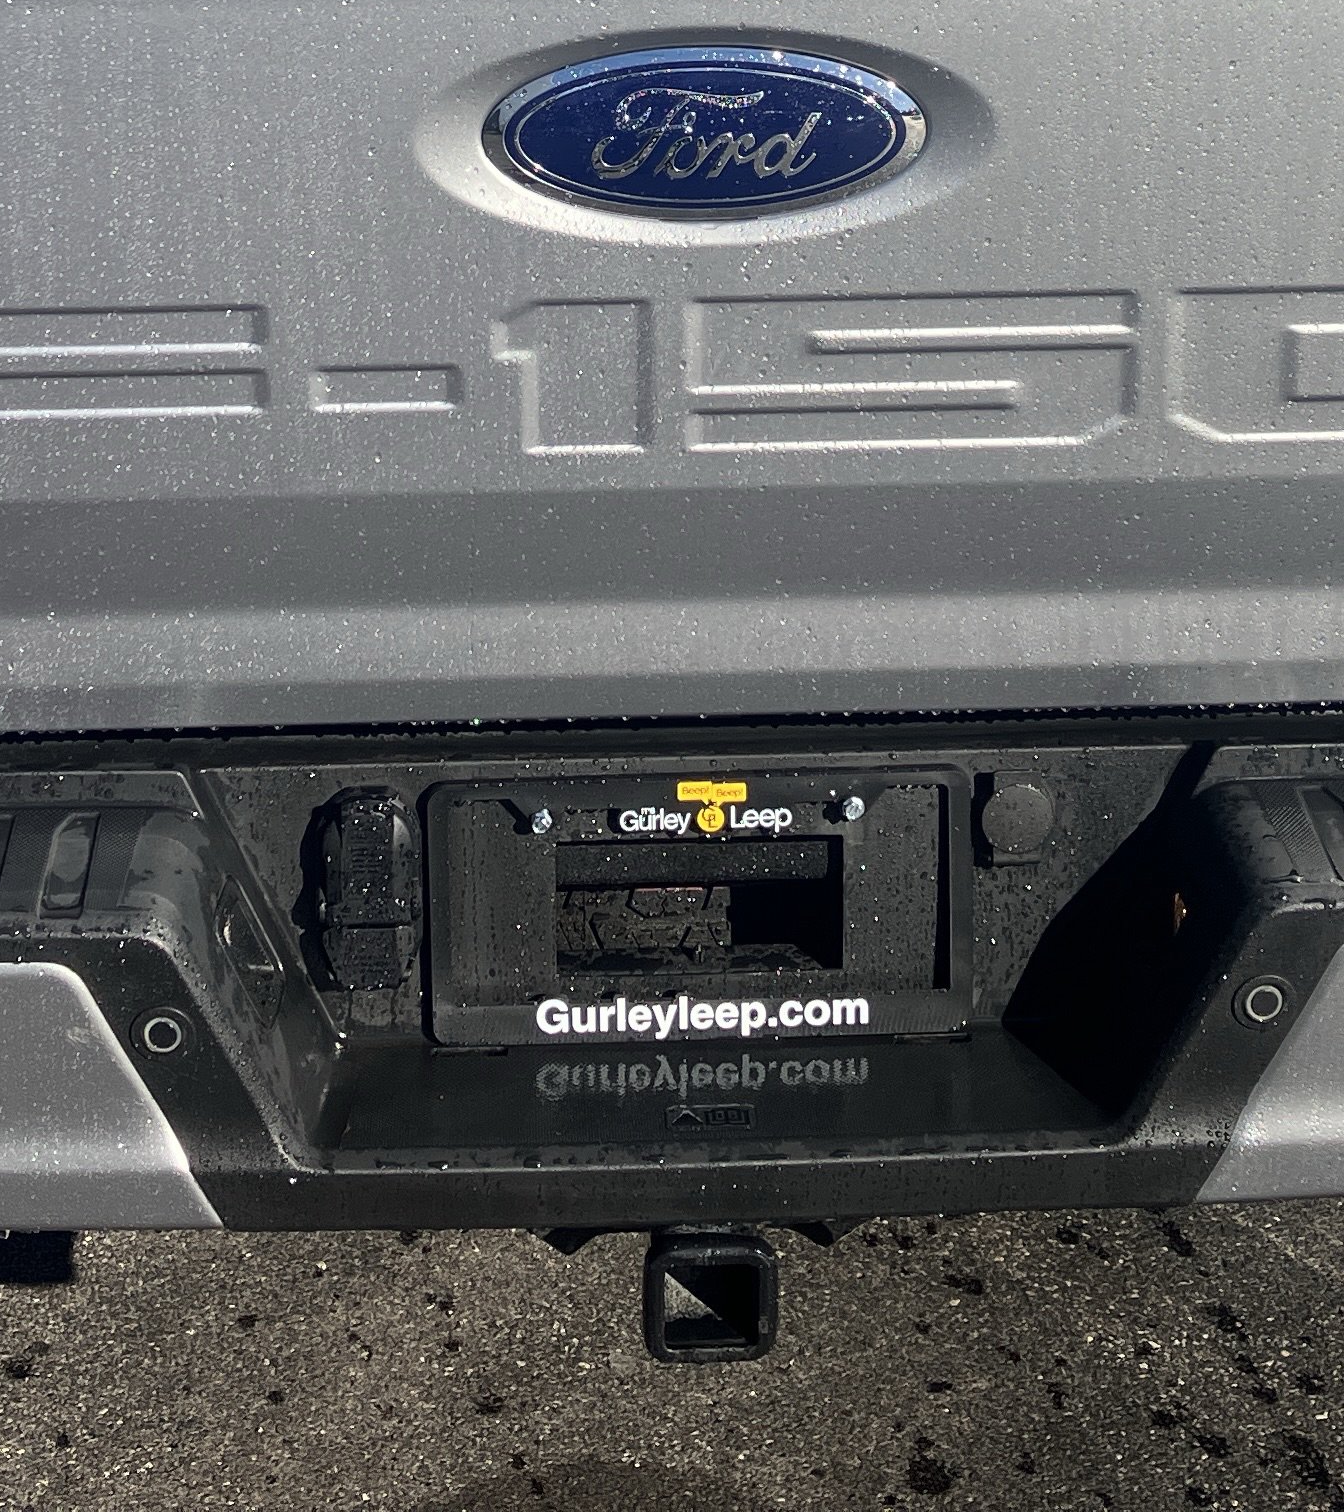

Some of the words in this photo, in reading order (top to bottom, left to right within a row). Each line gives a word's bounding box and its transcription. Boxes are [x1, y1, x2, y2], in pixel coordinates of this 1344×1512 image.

[590, 87, 823, 181] Ford
[682, 786, 709, 795] Beep!
[716, 788, 744, 798] Beep!
[619, 807, 692, 835] Gurley
[730, 804, 793, 833] Leep
[535, 995, 870, 1039] Gurleyleep.com
